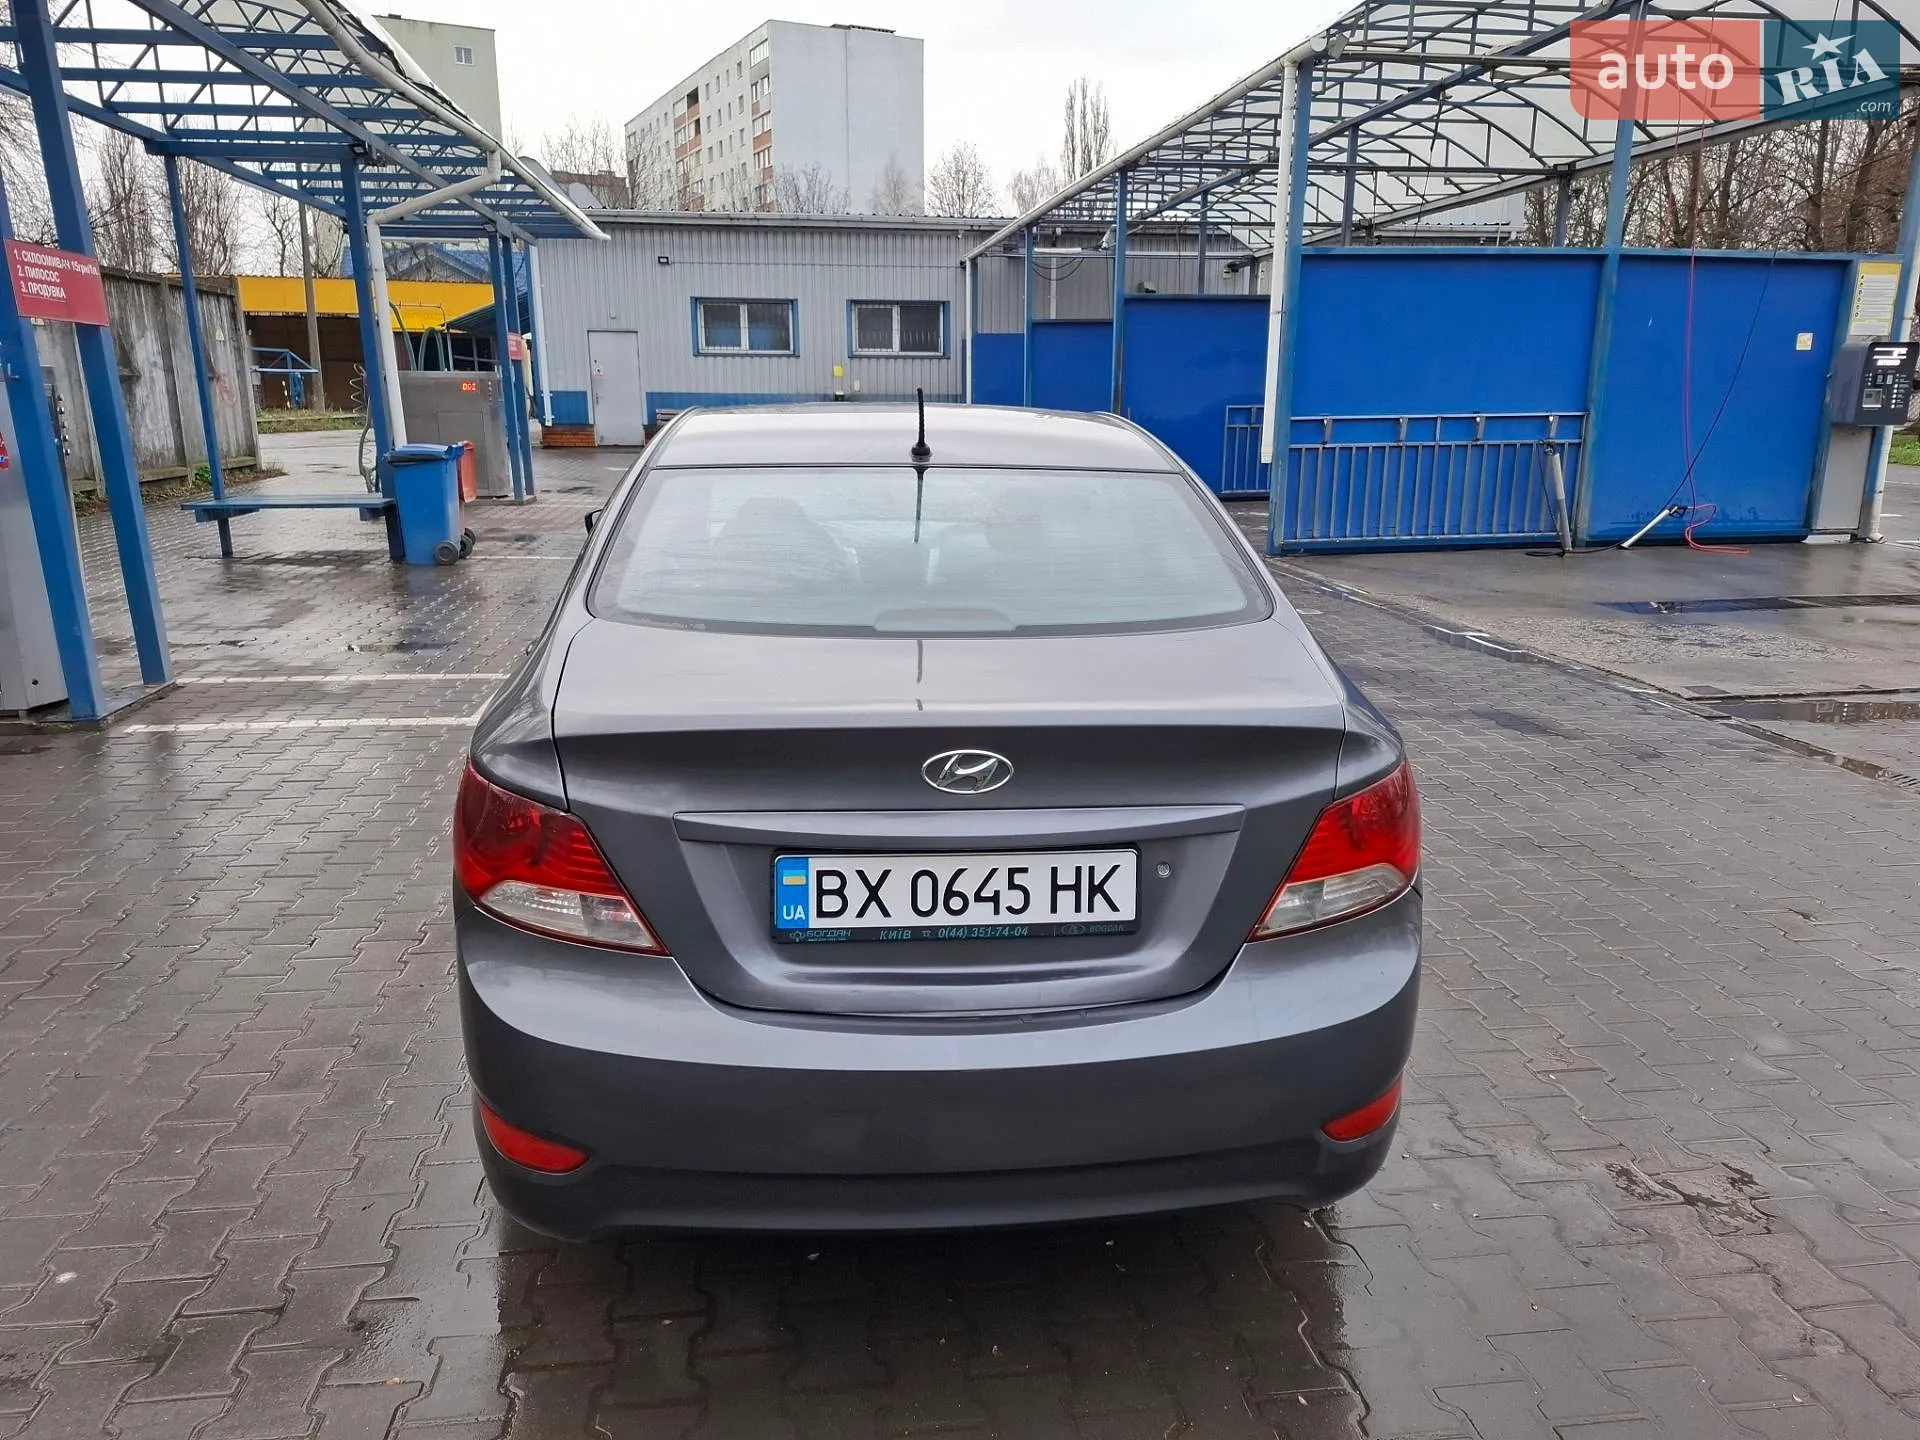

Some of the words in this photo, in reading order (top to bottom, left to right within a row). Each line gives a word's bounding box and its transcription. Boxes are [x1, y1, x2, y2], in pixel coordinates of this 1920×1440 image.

[14, 248, 21, 261] 1.
[22, 250, 71, 270] СКЛООМИВАЧ
[17, 265, 24, 277] 2.
[25, 265, 60, 283] ПИЛОСОС
[20, 281, 28, 293] 3.
[28, 282, 66, 299] ПРОДУВКА
[816, 869, 892, 918] BX
[911, 867, 1031, 918] 0645
[1050, 864, 1121, 914] HK
[783, 904, 806, 920] UA
[806, 929, 851, 938] БОГДАН
[879, 928, 912, 940] КИЇВ
[938, 926, 967, 939] 0(44)
[971, 926, 1029, 938] 351-74-04
